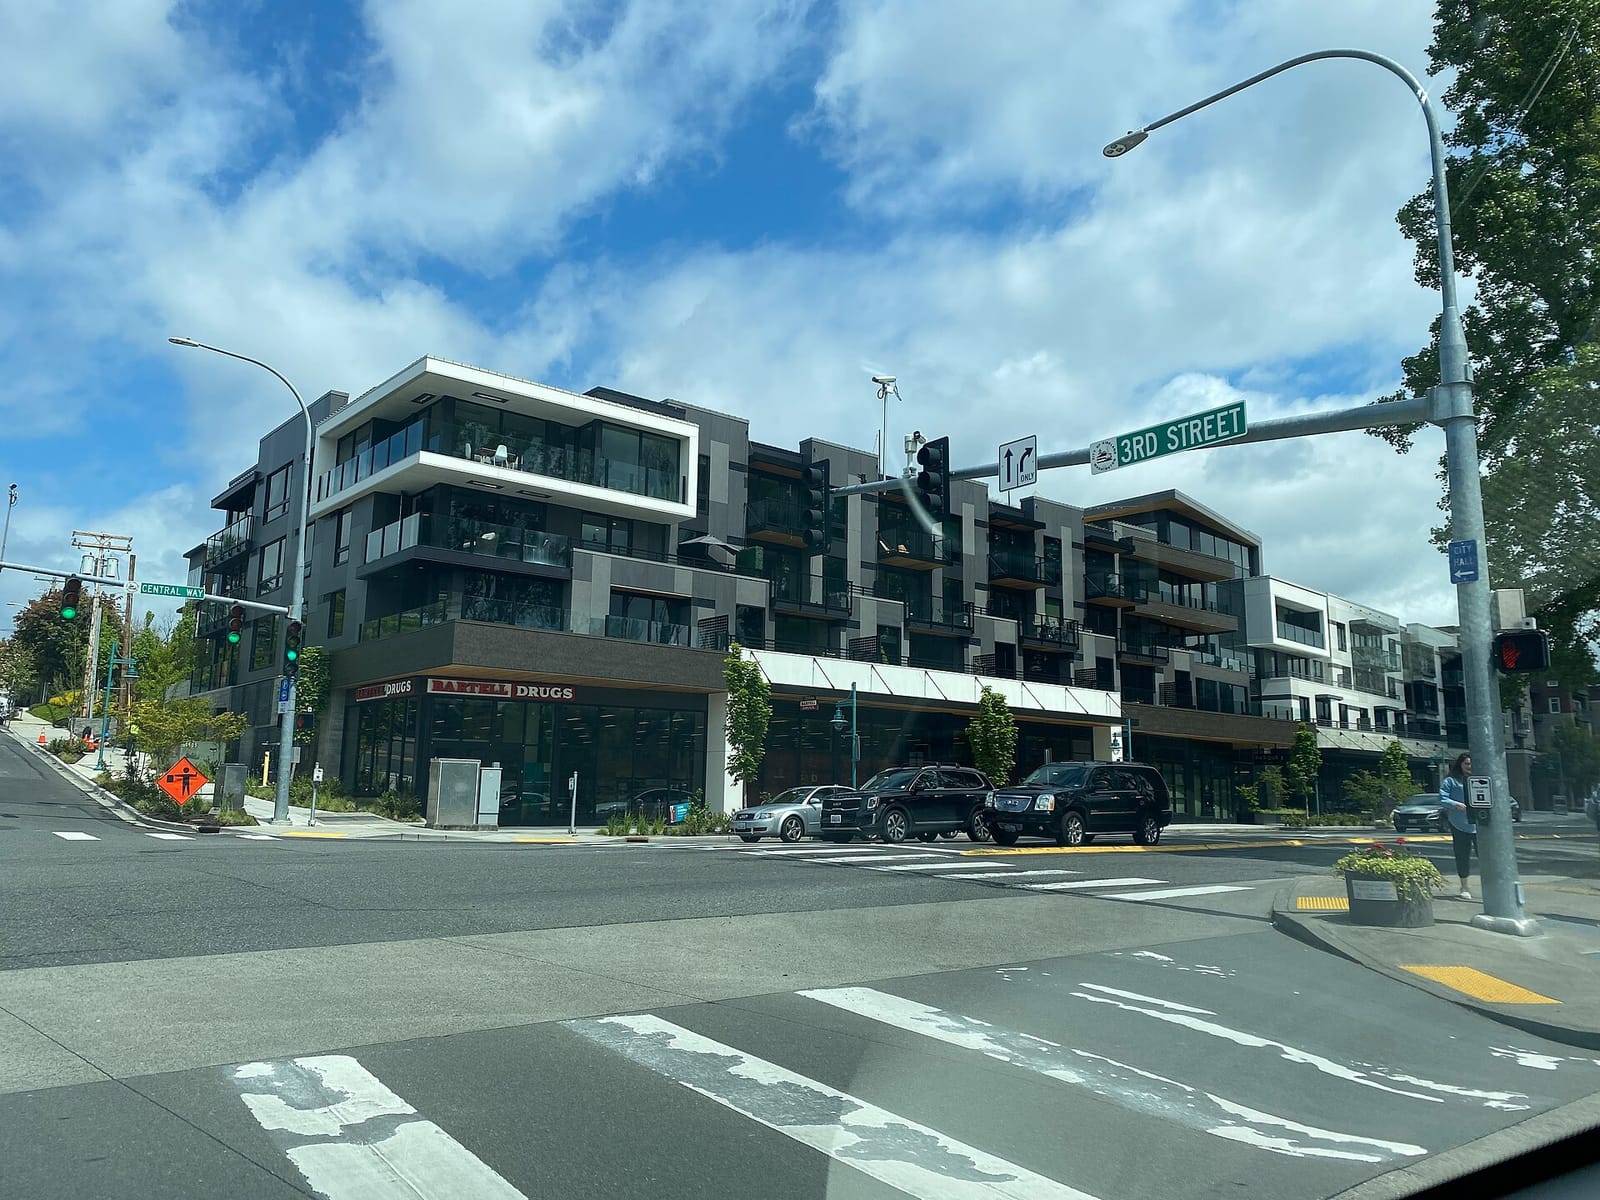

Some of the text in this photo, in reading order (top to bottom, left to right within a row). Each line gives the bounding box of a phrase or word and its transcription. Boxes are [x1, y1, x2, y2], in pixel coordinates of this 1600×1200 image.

[1120, 432, 1158, 463] 3RD
[1166, 407, 1241, 450] STREET
[1020, 472, 1035, 482] ONLY
[1454, 545, 1472, 554] CITY
[141, 584, 204, 597] CENTRAL WAY
[386, 680, 412, 695] DRUGS
[516, 685, 573, 699] DRUGS
